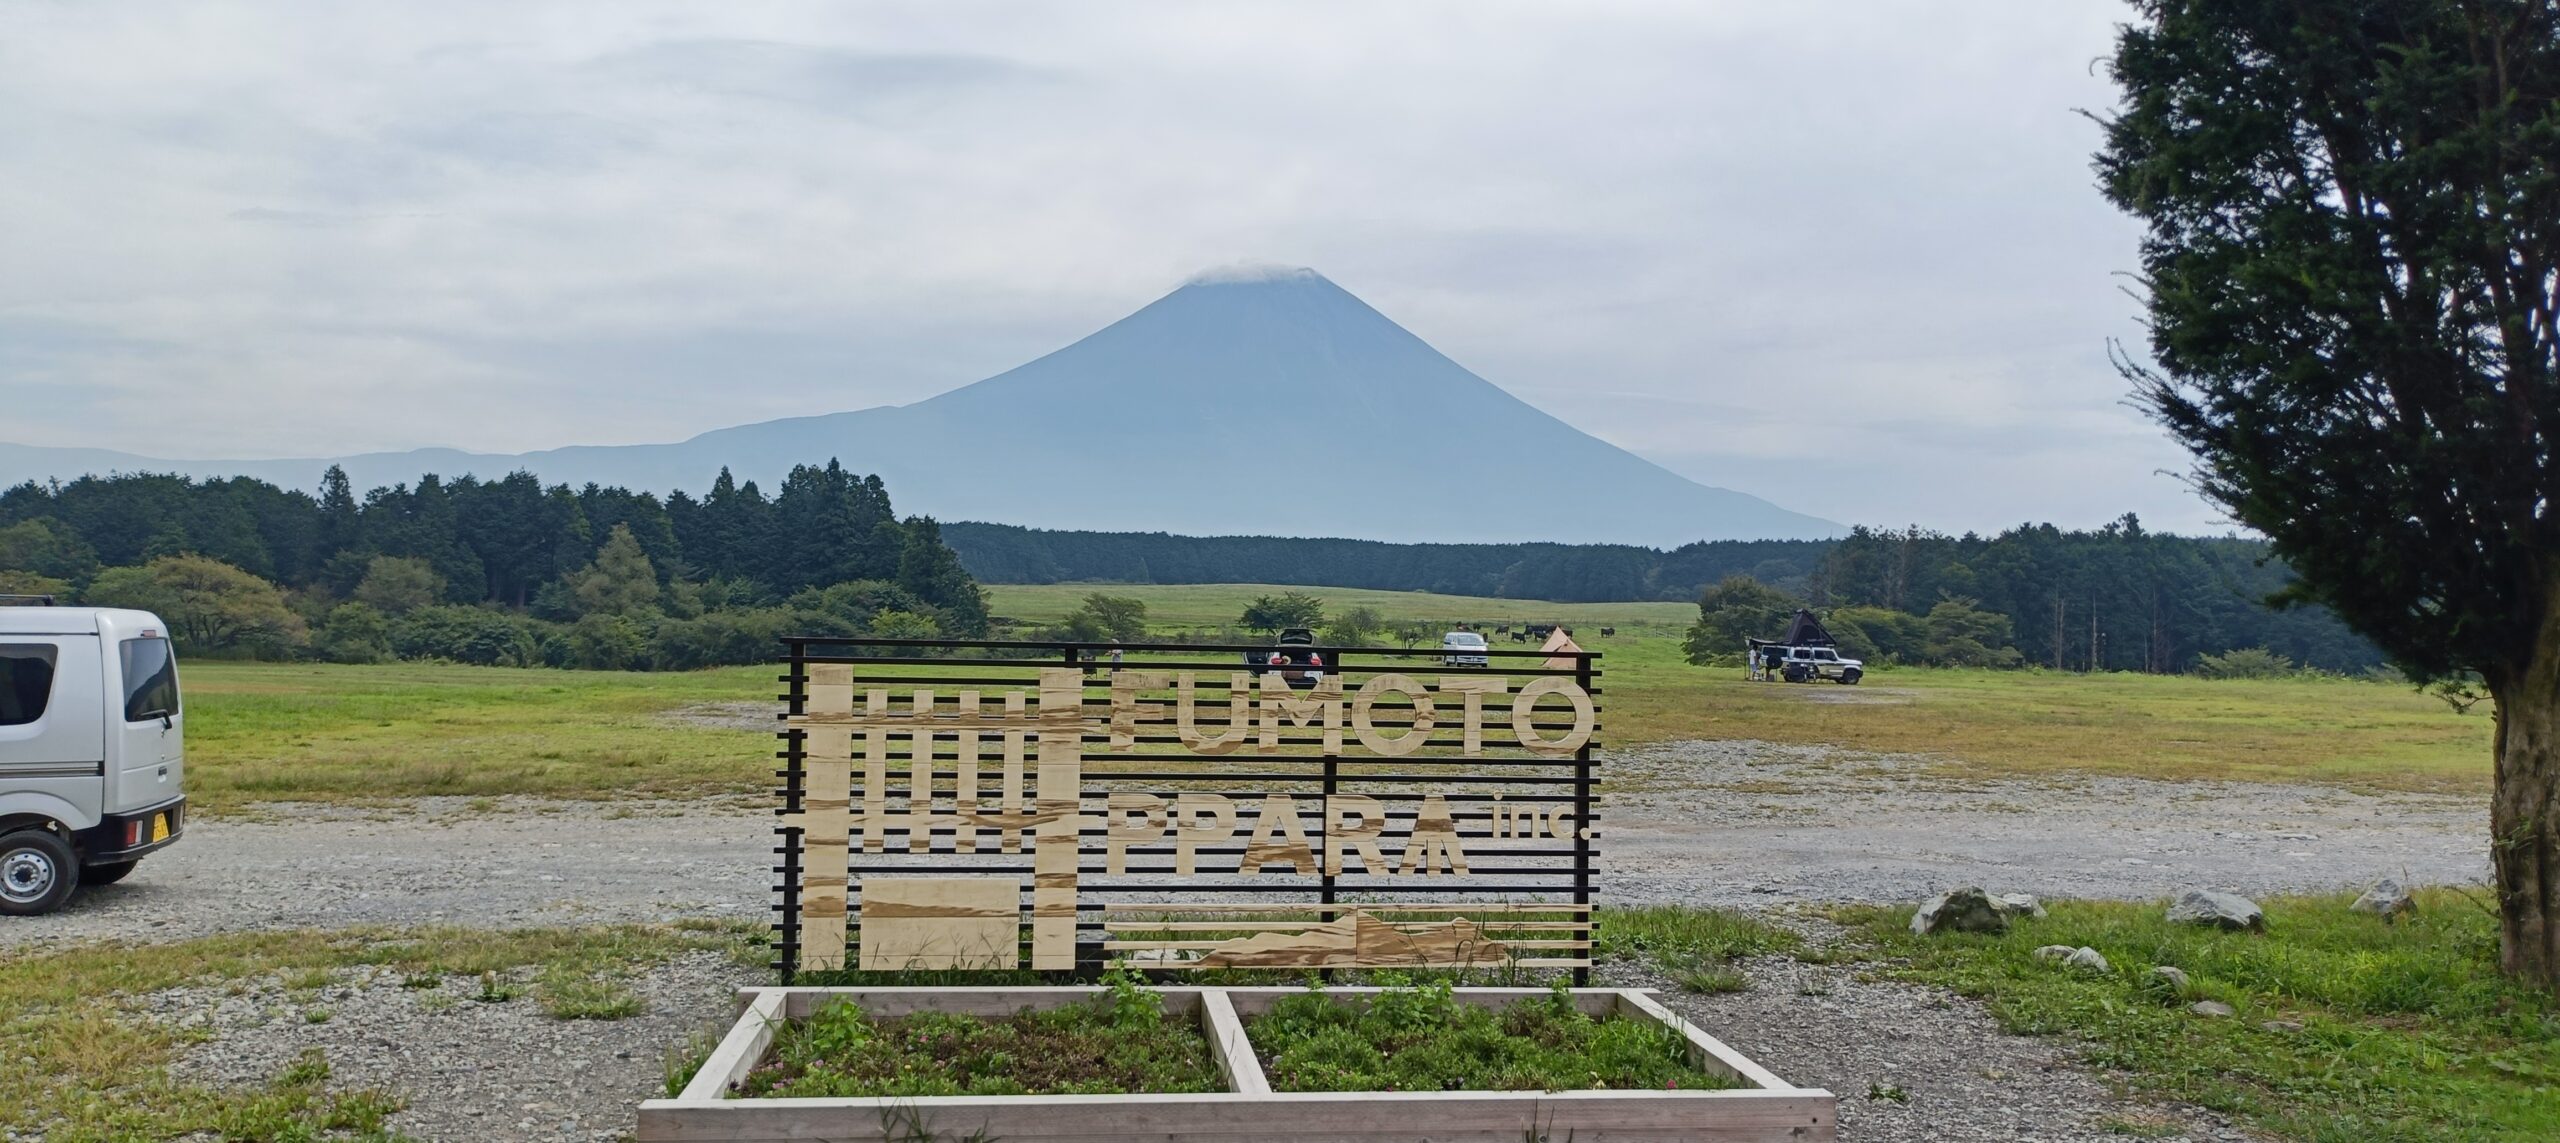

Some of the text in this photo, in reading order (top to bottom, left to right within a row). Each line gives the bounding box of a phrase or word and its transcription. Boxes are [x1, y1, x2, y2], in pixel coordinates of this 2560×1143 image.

[1110, 671, 1595, 758] FUMOTO
[1106, 789, 1592, 877] PPARA inc.
